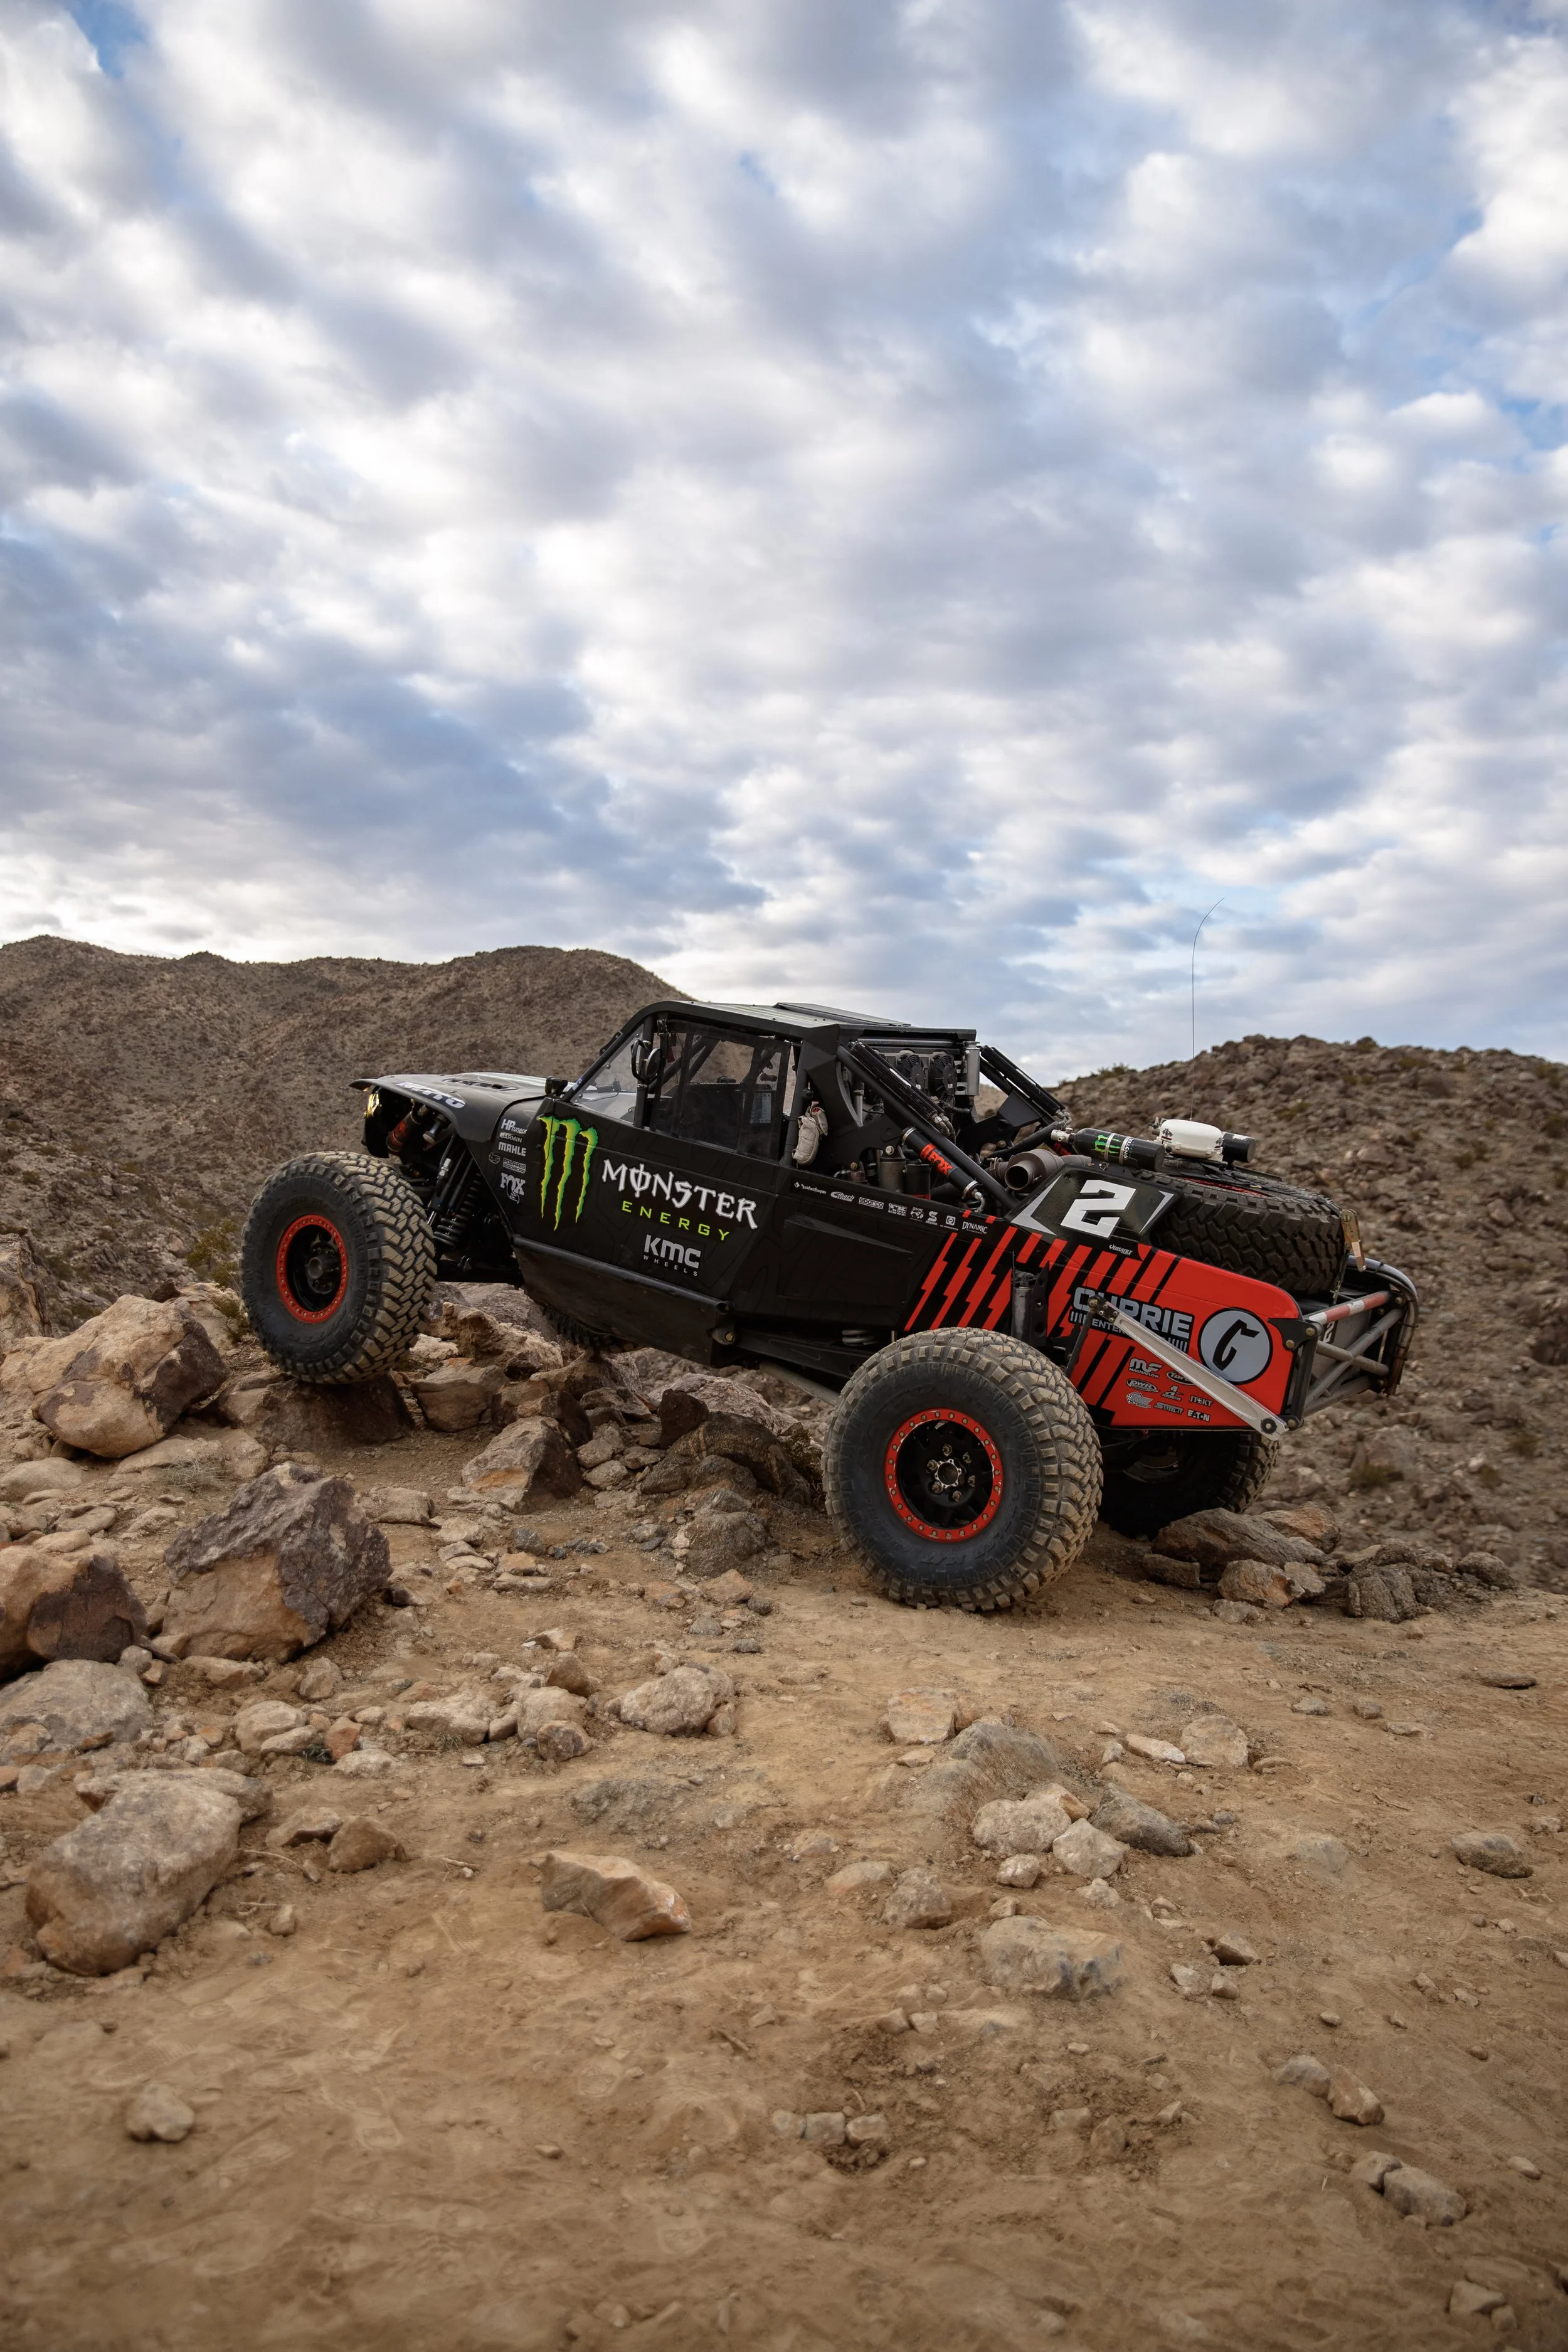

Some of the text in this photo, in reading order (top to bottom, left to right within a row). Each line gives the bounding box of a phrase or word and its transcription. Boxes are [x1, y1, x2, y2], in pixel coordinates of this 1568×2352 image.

[501, 1132, 522, 1143] GARMIN
[498, 1142, 526, 1157] MAHLE
[500, 1172, 526, 1201] FOX
[859, 1197, 884, 1208] sparco
[1060, 1179, 1136, 1239] 2
[622, 1200, 730, 1241] ENERGY
[962, 1221, 987, 1234] DYNAMIC
[644, 1234, 702, 1269] KMC
[644, 1255, 698, 1277] WHEELS
[1129, 1368, 1160, 1378] MAGNAFLOW
[1190, 1396, 1212, 1407] JTEKT
